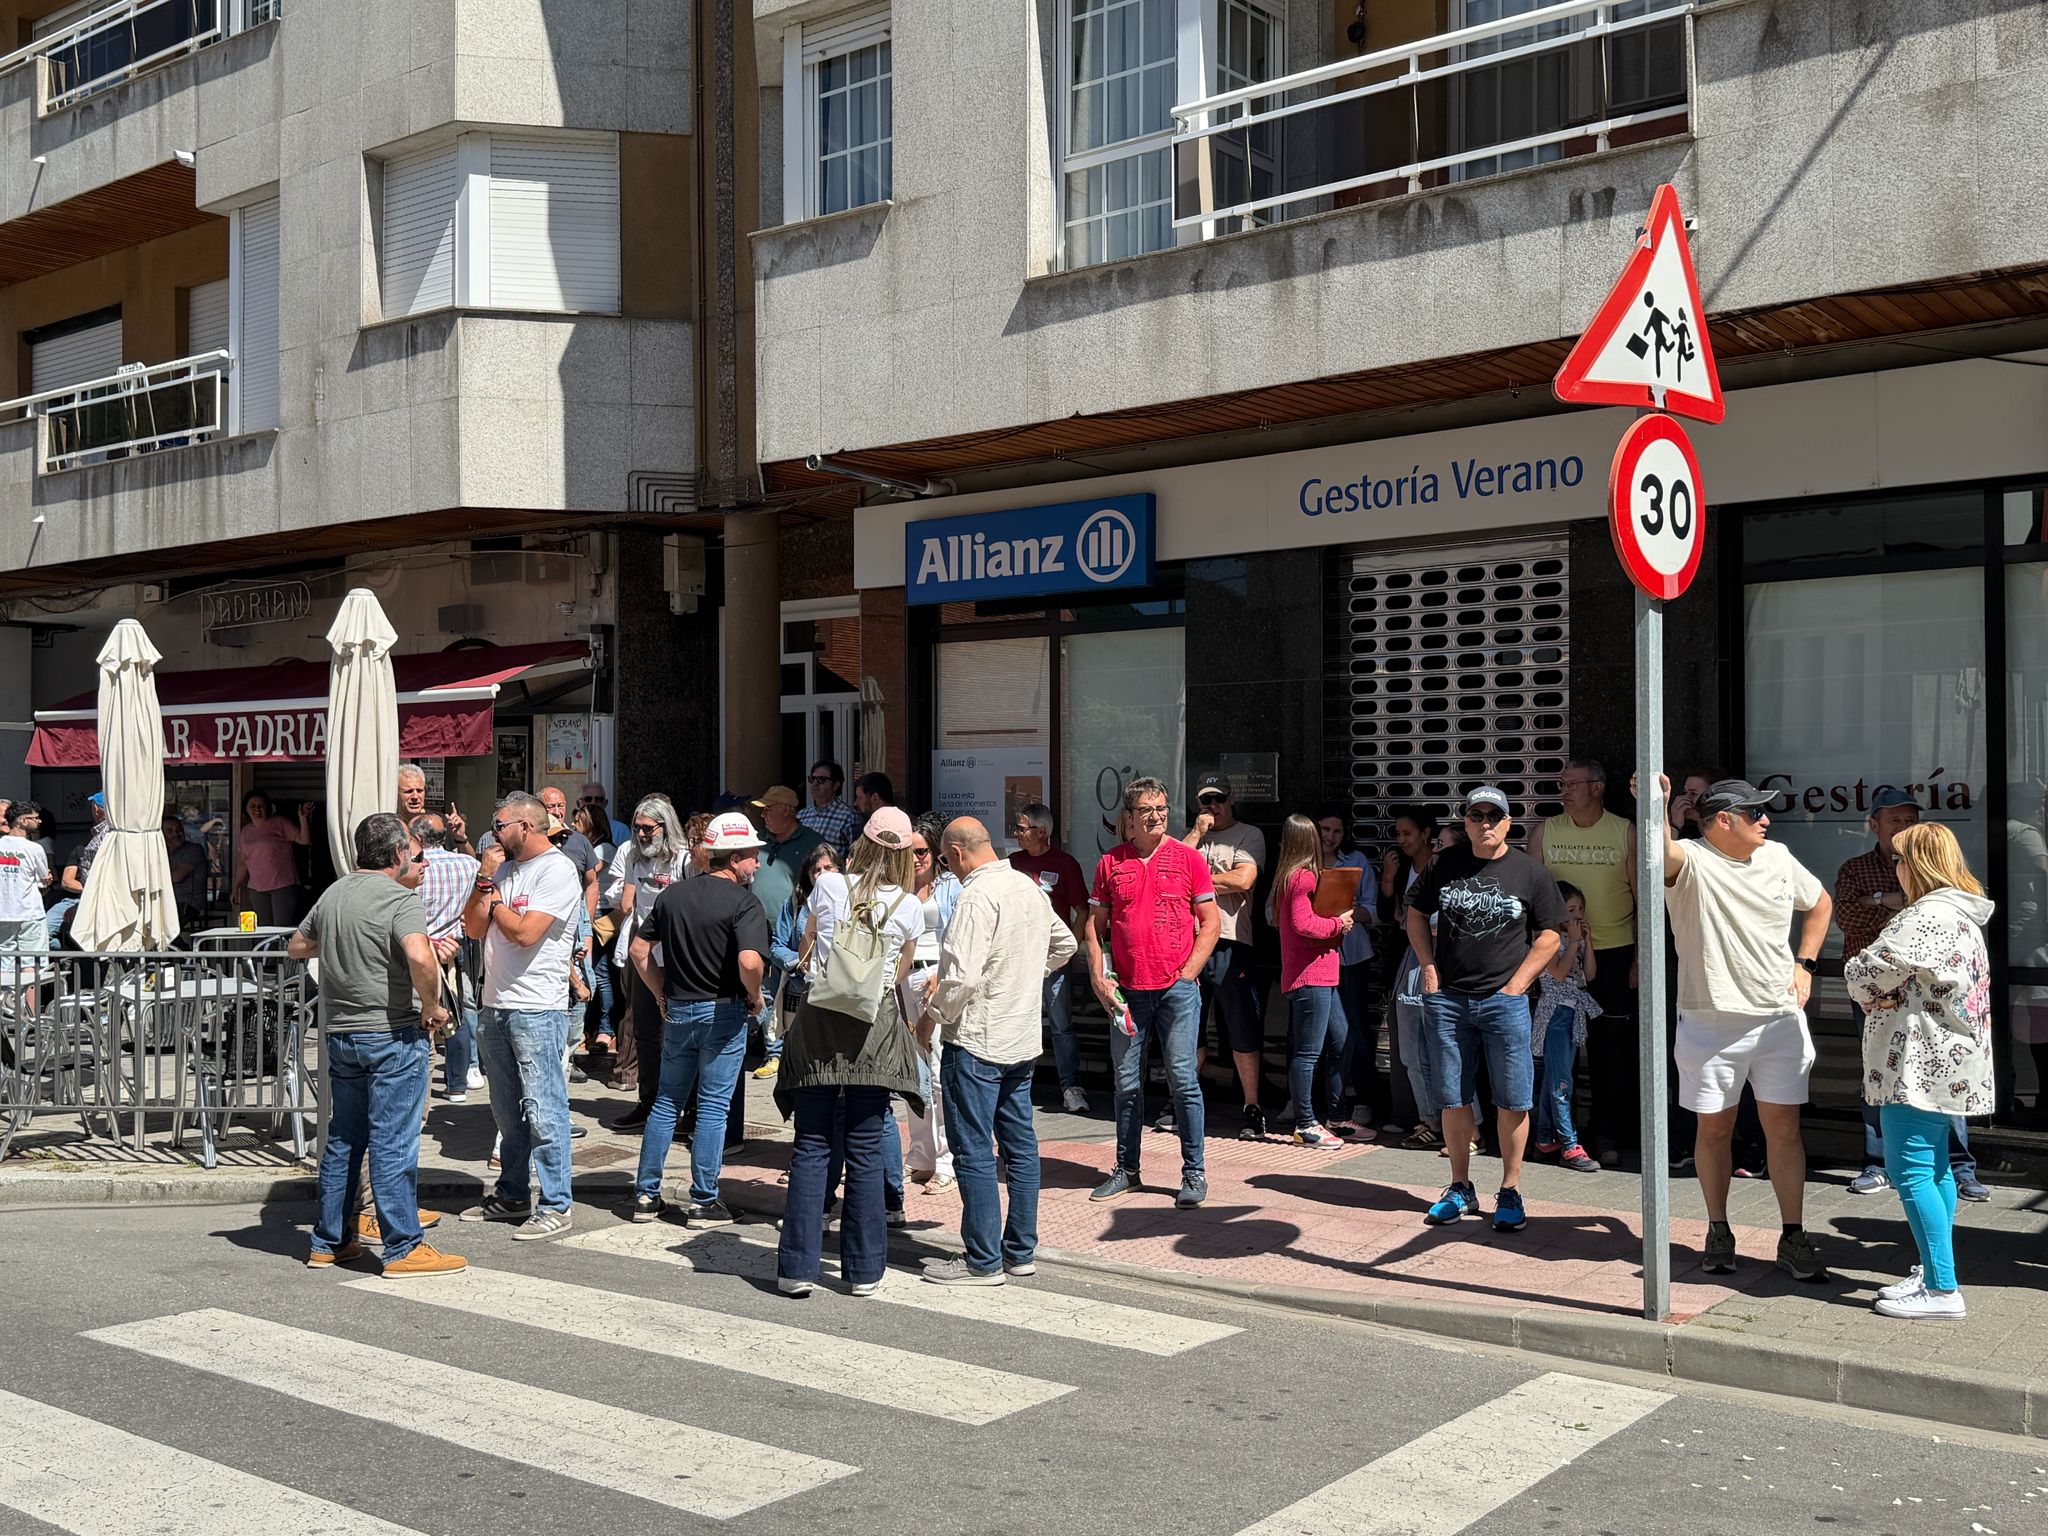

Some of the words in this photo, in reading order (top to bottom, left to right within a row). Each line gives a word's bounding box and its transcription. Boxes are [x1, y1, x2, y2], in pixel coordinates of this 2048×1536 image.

[1300, 465, 1438, 516] Gestoría
[1451, 455, 1584, 498] Verano
[1640, 473, 1692, 540] 30
[916, 532, 1065, 585] Allianz
[214, 713, 328, 757] PADRIA
[940, 759, 966, 767] Allianz
[1471, 791, 1502, 801] adidas
[1758, 767, 1973, 813] Gestría
[1450, 887, 1504, 914] AC/DC
